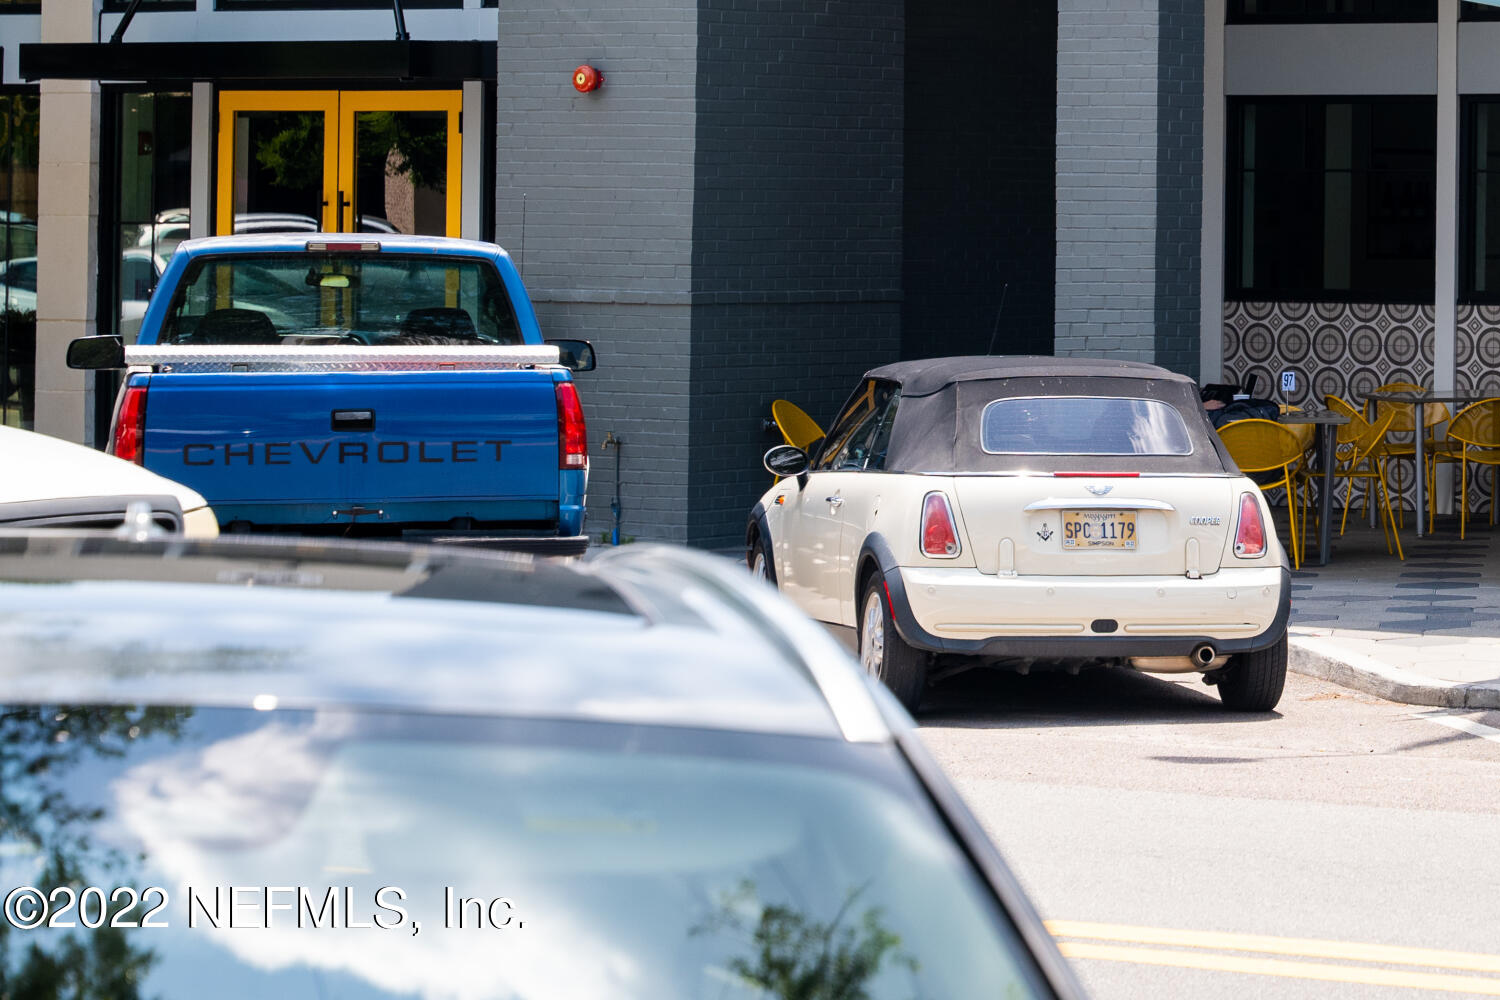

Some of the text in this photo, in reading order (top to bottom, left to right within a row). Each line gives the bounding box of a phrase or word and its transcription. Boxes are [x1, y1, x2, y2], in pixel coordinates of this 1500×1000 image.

[1283, 373, 1294, 387] 97
[182, 440, 513, 466] CHEVROLET
[1065, 522, 1135, 539] SPC 1179
